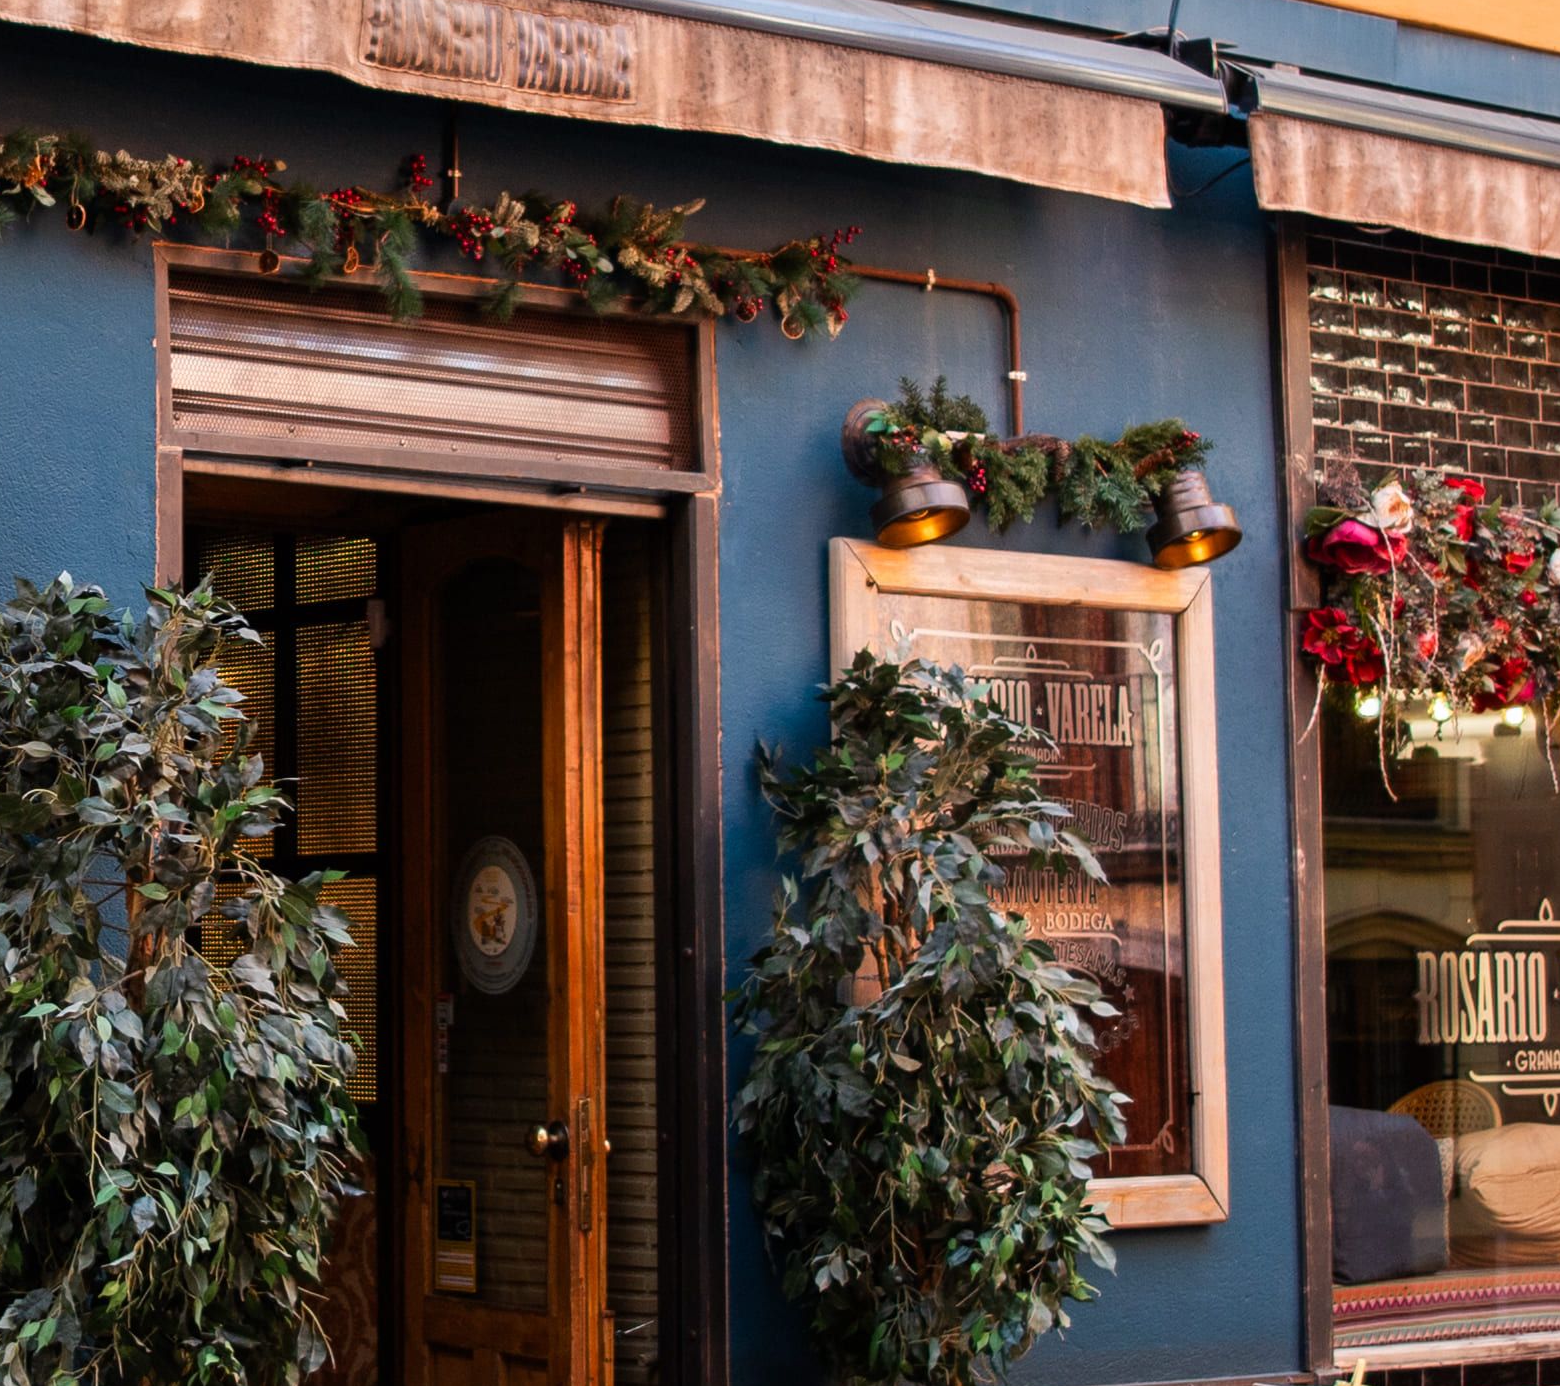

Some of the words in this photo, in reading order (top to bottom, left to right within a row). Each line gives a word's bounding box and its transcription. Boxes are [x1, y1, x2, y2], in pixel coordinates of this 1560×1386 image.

[1044, 681, 1134, 746] VARELA
[1045, 912, 1114, 931] BODEGA
[1413, 951, 1548, 1045] ROSARIO
